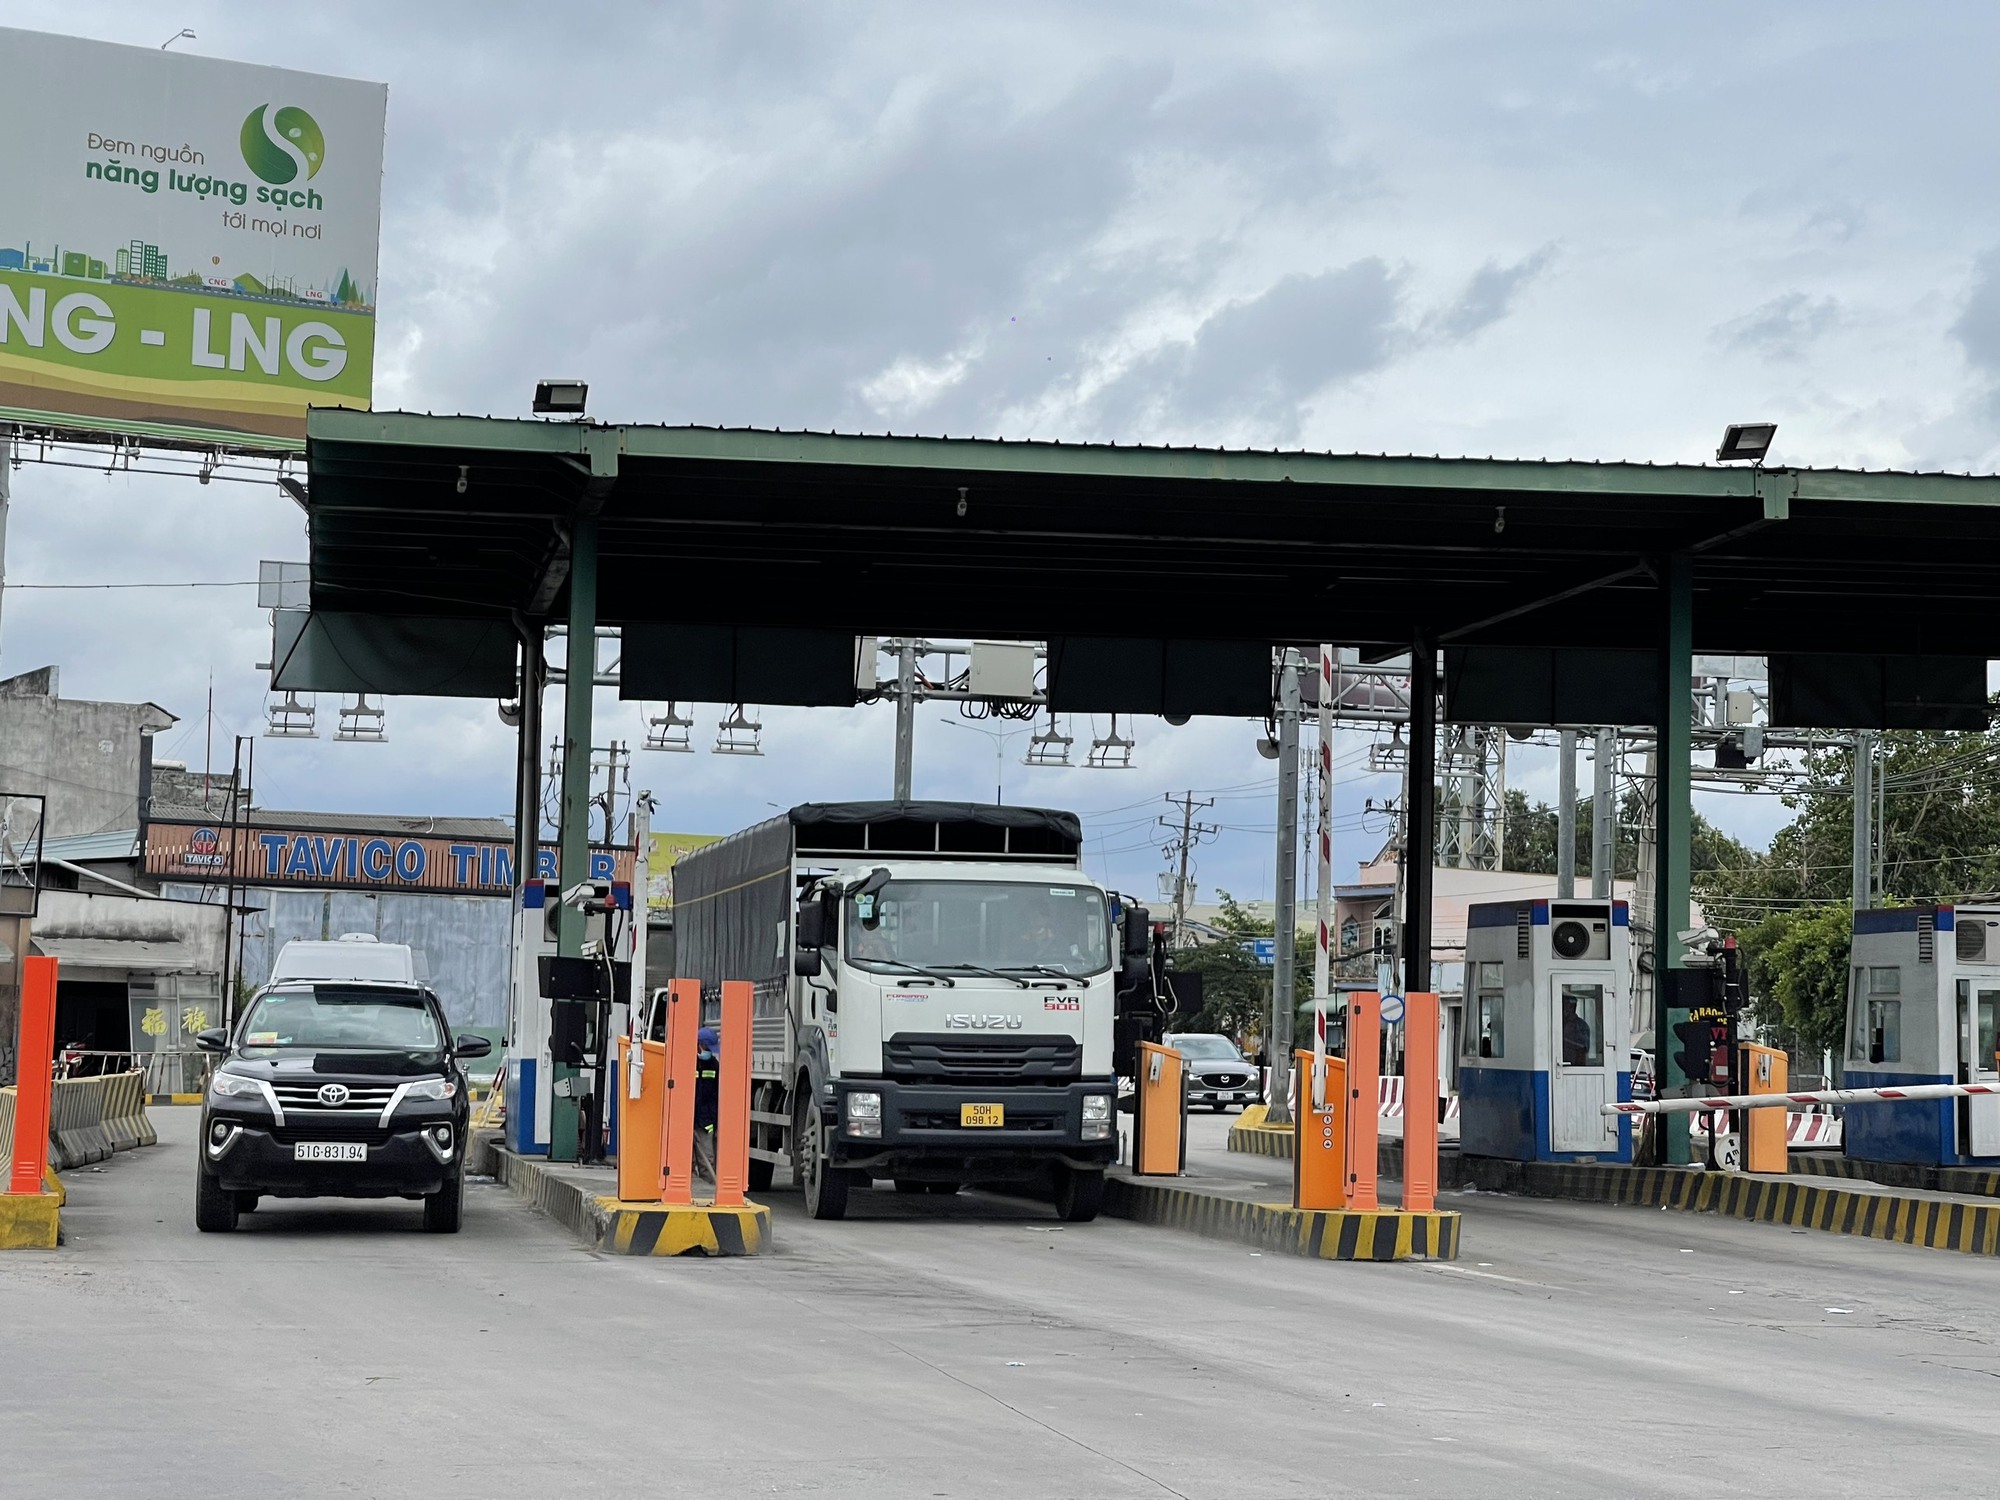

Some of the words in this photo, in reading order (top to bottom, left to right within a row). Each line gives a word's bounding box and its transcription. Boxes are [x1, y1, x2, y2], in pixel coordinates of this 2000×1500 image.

[87, 132, 135, 155] Đem
[141, 143, 205, 165] nguồn
[86, 158, 159, 194] năng
[169, 168, 248, 206] lượng
[256, 185, 323, 211] sạch
[222, 211, 246, 230] tới
[252, 218, 287, 238] mọi
[293, 223, 322, 240] nơi
[208, 277, 227, 287] CNG
[305, 290, 323, 299] LNG
[191, 307, 348, 382] LNG
[187, 855, 221, 864] TAVICO
[259, 833, 427, 882] TAVICO
[450, 843, 616, 887] TIMBR
[1044, 996, 1079, 1004] FVR
[945, 1014, 1022, 1030] ISUZU
[973, 1105, 992, 1115] 50H
[965, 1115, 999, 1125] 098.12
[297, 1145, 363, 1159] 51G-831.94
